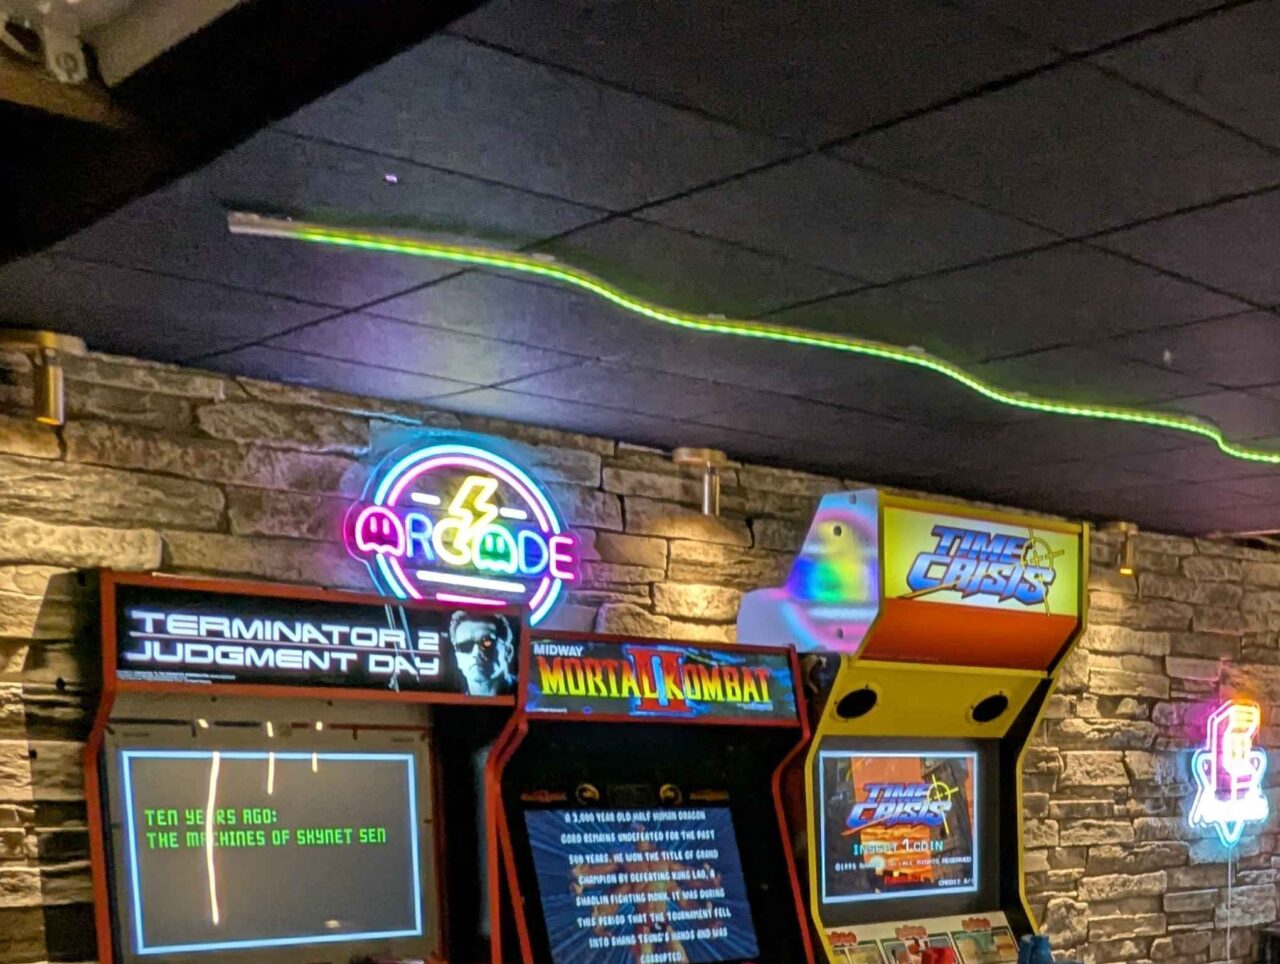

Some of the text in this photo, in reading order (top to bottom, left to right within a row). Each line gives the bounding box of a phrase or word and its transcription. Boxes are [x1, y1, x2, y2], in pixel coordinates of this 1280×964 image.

[931, 525, 1031, 562] TIME
[907, 552, 1056, 605] CRISIS
[131, 609, 406, 649] TERMINATOR
[126, 640, 440, 676] JUDGMENT DAY
[533, 643, 584, 657] MIDWAY
[536, 655, 771, 703] MORTAL KOMBAT
[864, 782, 931, 802] TIME
[144, 808, 277, 826] TEN YERS AGO:
[846, 801, 952, 829] CRISIS
[146, 832, 179, 849] THE
[272, 830, 289, 846] OF
[296, 829, 352, 845] SKYNET
[359, 828, 386, 844] SEN
